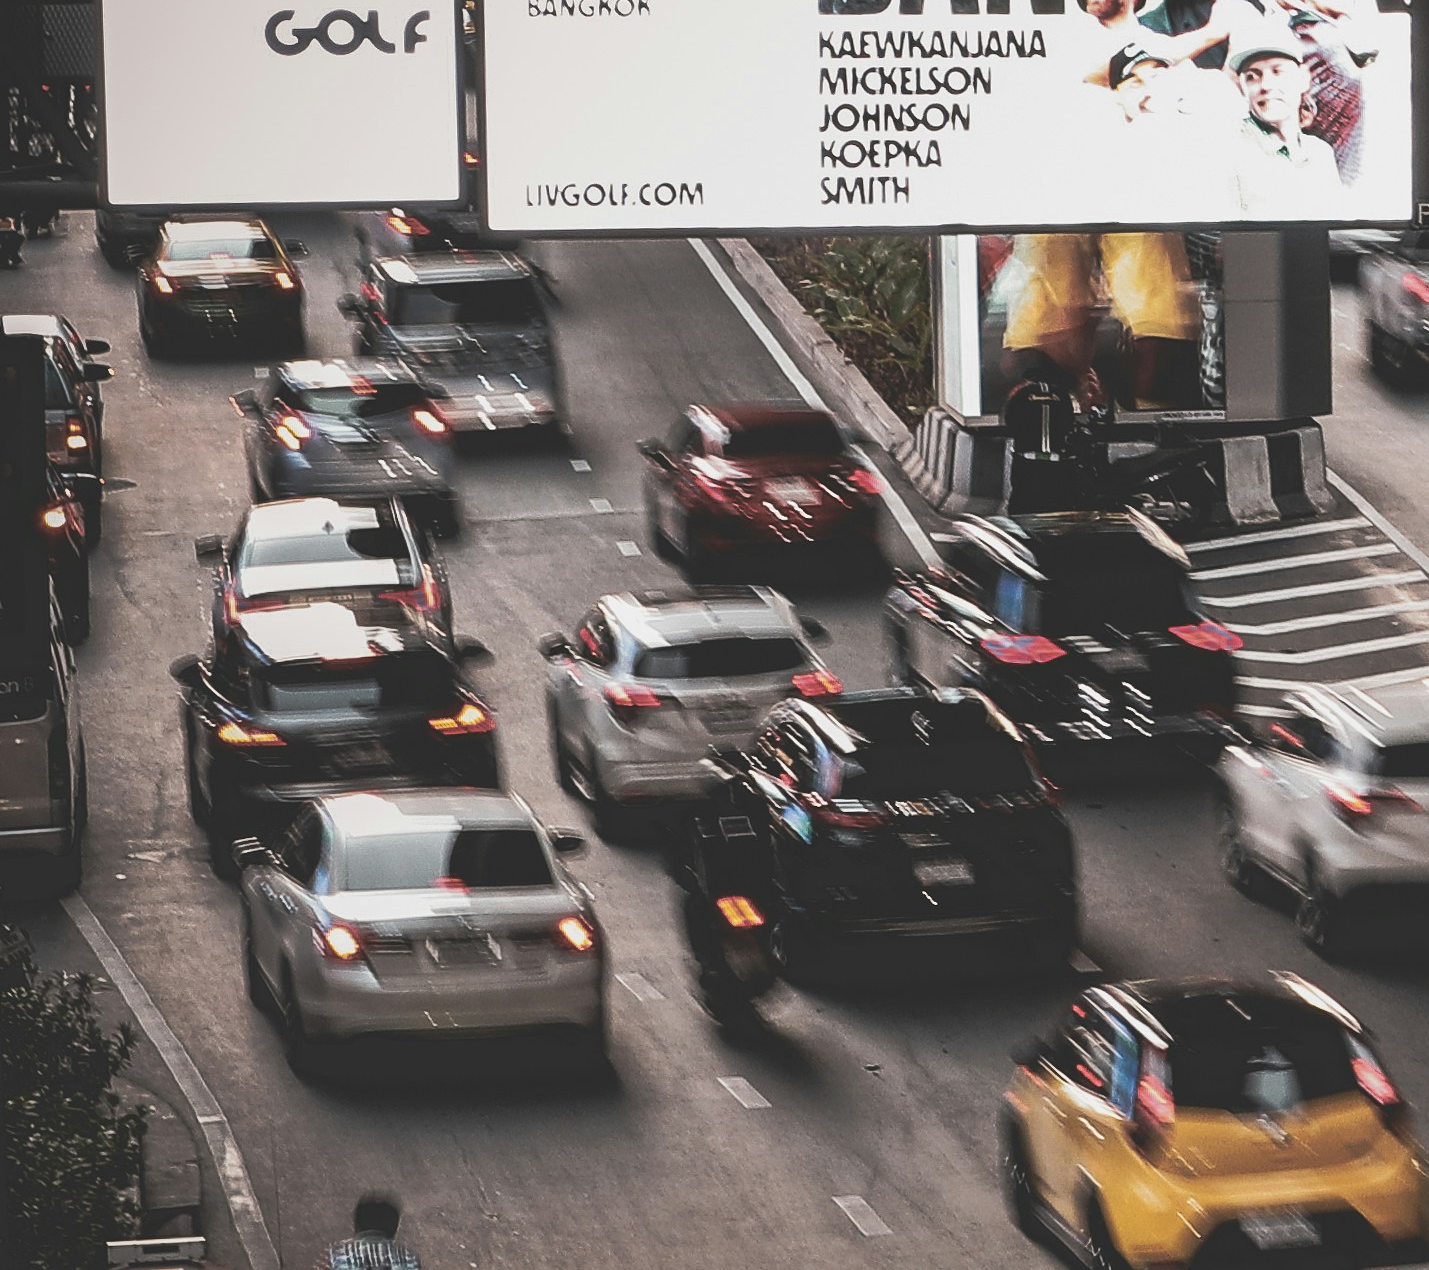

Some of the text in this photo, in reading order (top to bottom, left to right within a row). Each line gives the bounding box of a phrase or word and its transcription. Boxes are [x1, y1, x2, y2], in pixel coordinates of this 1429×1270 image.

[264, 9, 430, 56] GOLF
[818, 31, 1046, 58] KAEWKANJANA
[818, 67, 991, 94] MICKELSON
[818, 103, 970, 131] JOHNSON
[820, 139, 942, 167] KOEPKA
[526, 183, 704, 206] LIVGOLF.COM
[820, 176, 910, 205] SMITH
